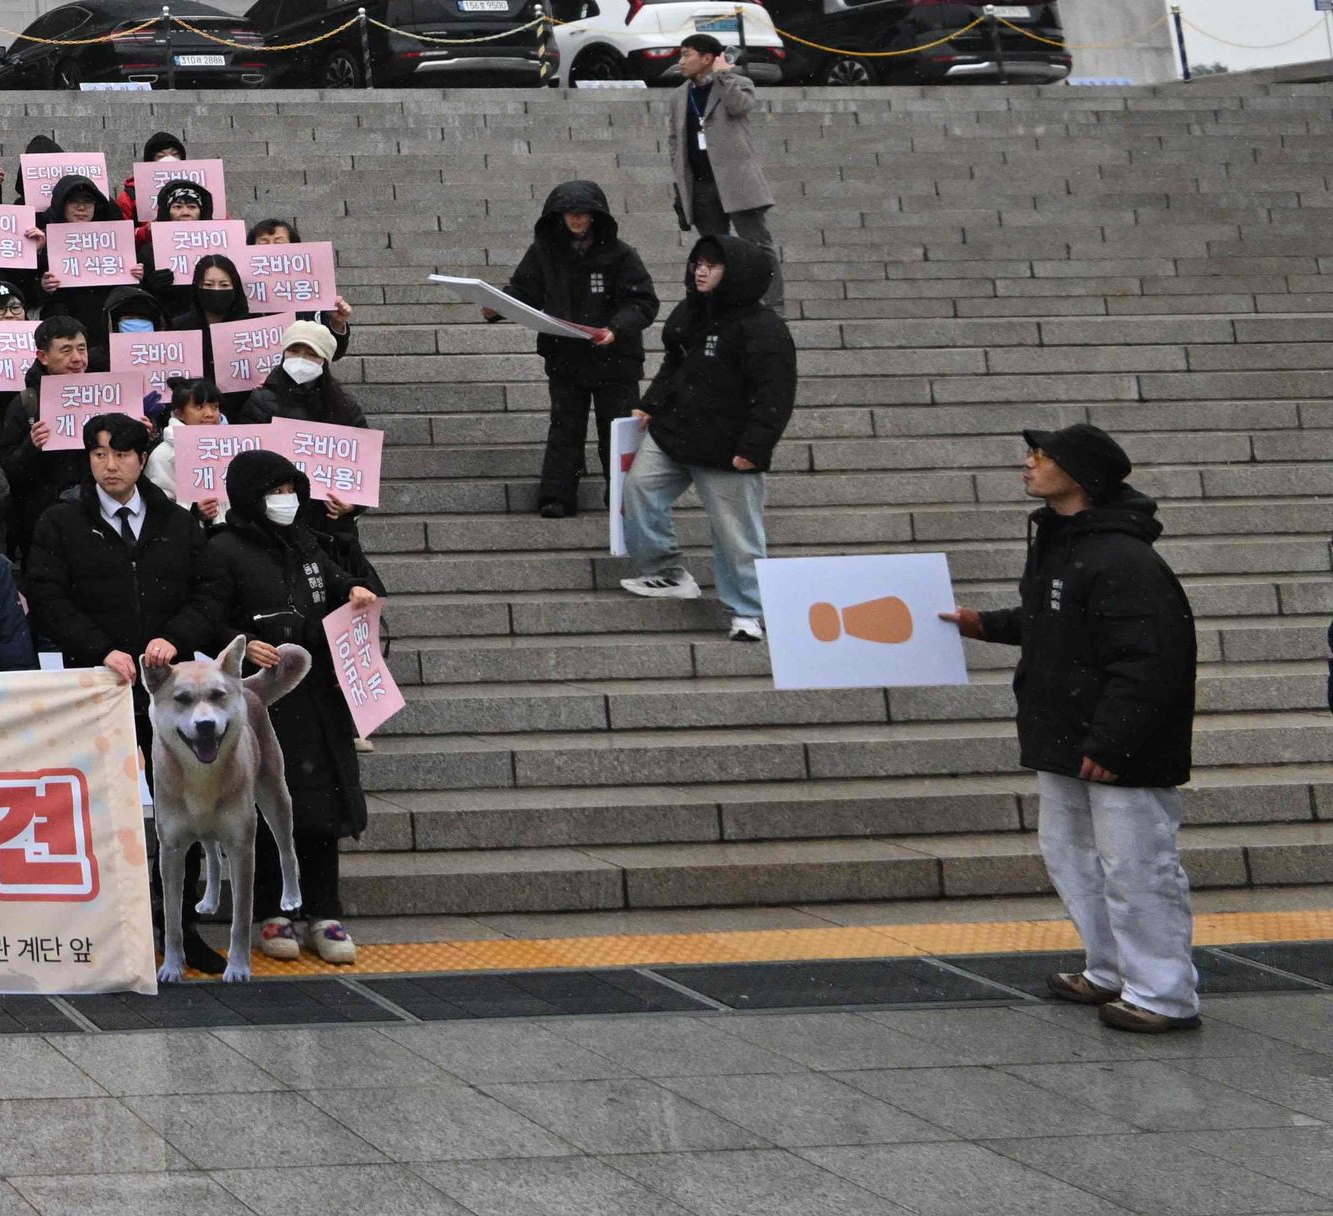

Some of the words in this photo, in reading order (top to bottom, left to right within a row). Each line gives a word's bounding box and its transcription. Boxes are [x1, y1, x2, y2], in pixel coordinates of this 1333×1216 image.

[26, 166, 63, 180] 드디어
[65, 232, 116, 251] 굿바이
[172, 231, 228, 250] 굿바이
[62, 257, 79, 276] 개
[87, 256, 123, 275] 식용!
[169, 255, 187, 275] 개
[250, 254, 311, 275] 굿바이
[247, 281, 266, 302] 개
[272, 280, 320, 301] 식용!
[233, 325, 283, 351] 굿바이
[130, 343, 183, 364] 굿바이
[230, 359, 249, 381] 개
[61, 384, 121, 408] 굿바이
[56, 414, 76, 437] 개
[292, 432, 358, 462] 굿바이
[192, 466, 213, 490] 개
[312, 469, 362, 491] 식용!
[17, 936, 62, 963] 계단
[69, 936, 93, 963] 앞
